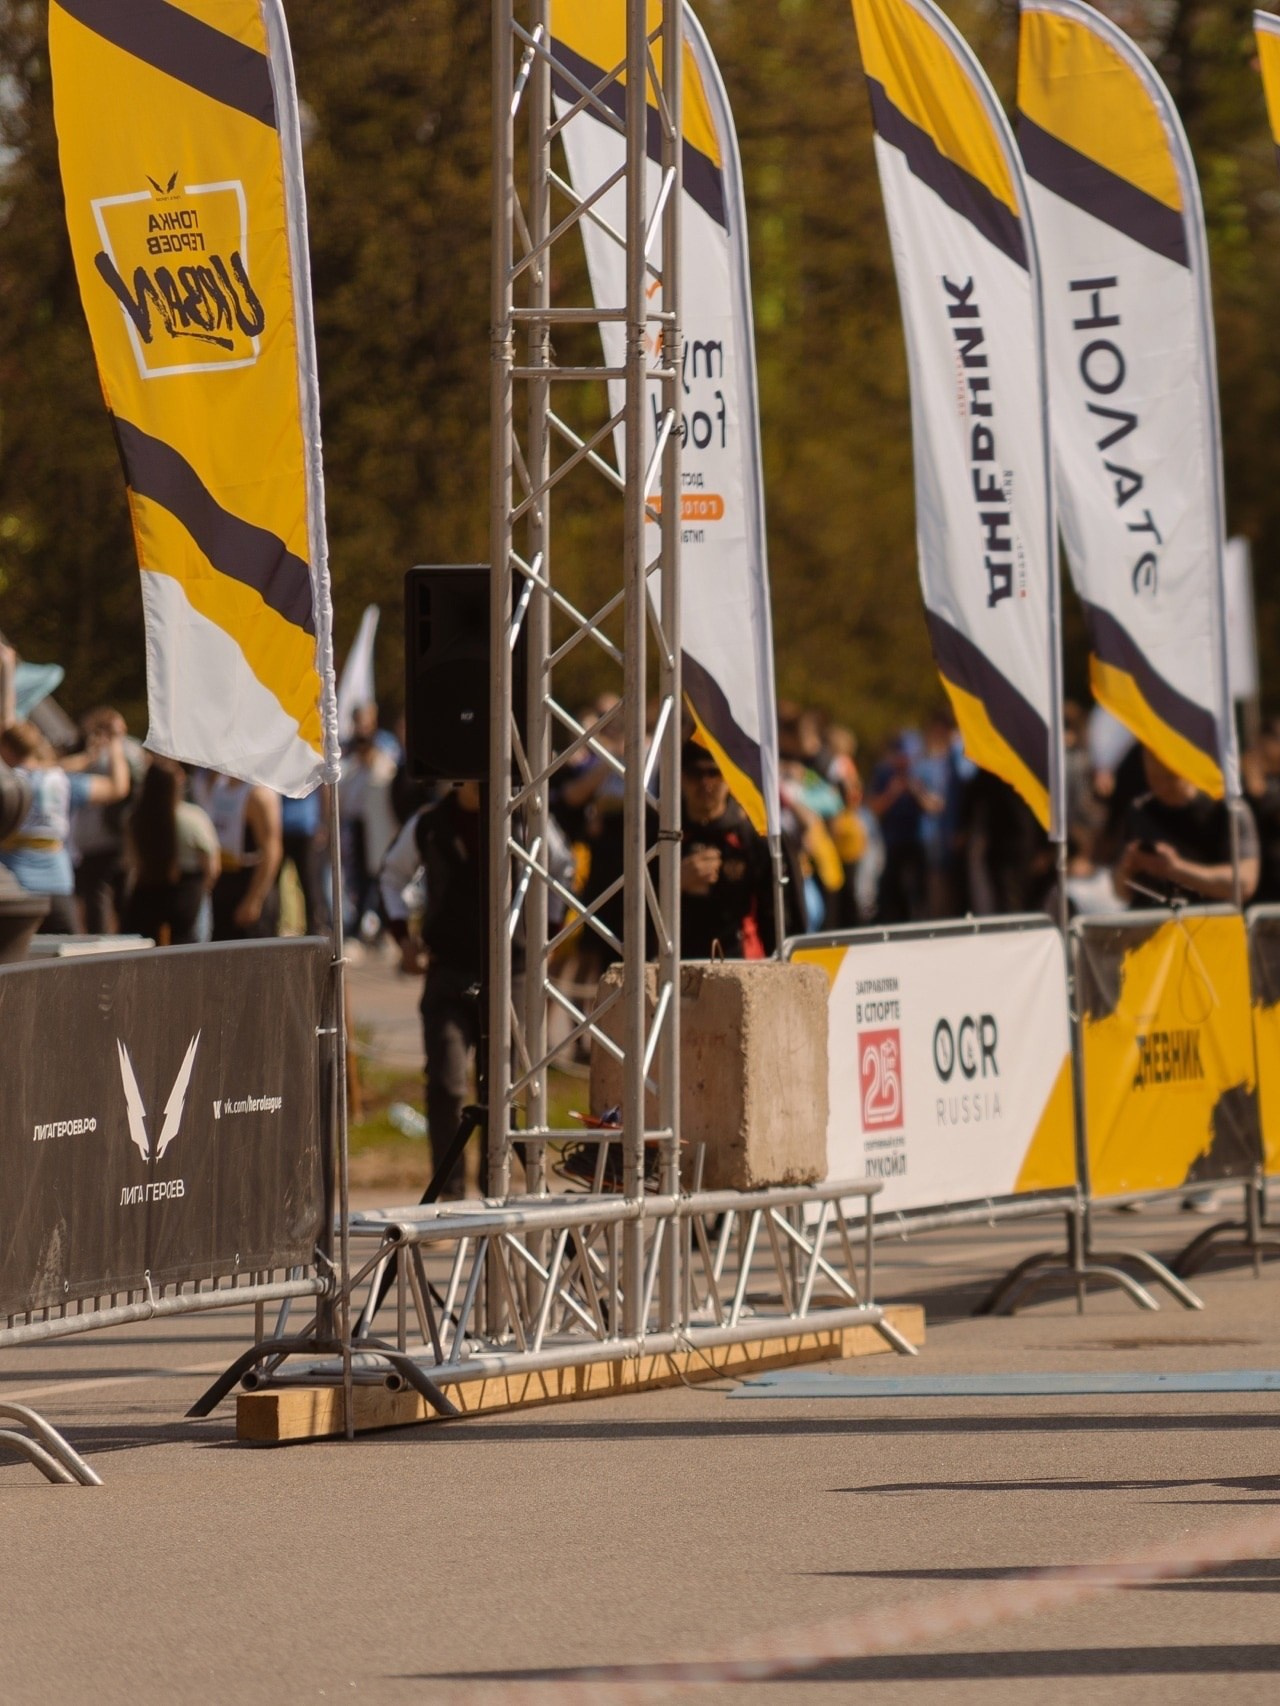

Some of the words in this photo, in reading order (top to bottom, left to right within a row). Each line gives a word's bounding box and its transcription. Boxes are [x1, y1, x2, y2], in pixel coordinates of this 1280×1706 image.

[856, 1004, 863, 1024] В
[864, 1000, 900, 1022] СПОРТЕ
[933, 1014, 1000, 1084] OCR
[1132, 1030, 1204, 1091] ДНЕВНИК
[224, 1094, 282, 1115] vk.com/heroleague
[937, 1093, 1003, 1127] RUSSIA
[33, 1117, 97, 1142] ЛИГАГЕРОЕВ.РФ
[865, 1152, 907, 1178] ЛУКОЙЛ
[120, 1186, 144, 1206] ЛИГА
[145, 1179, 185, 1202] ГЕРОЕВ
